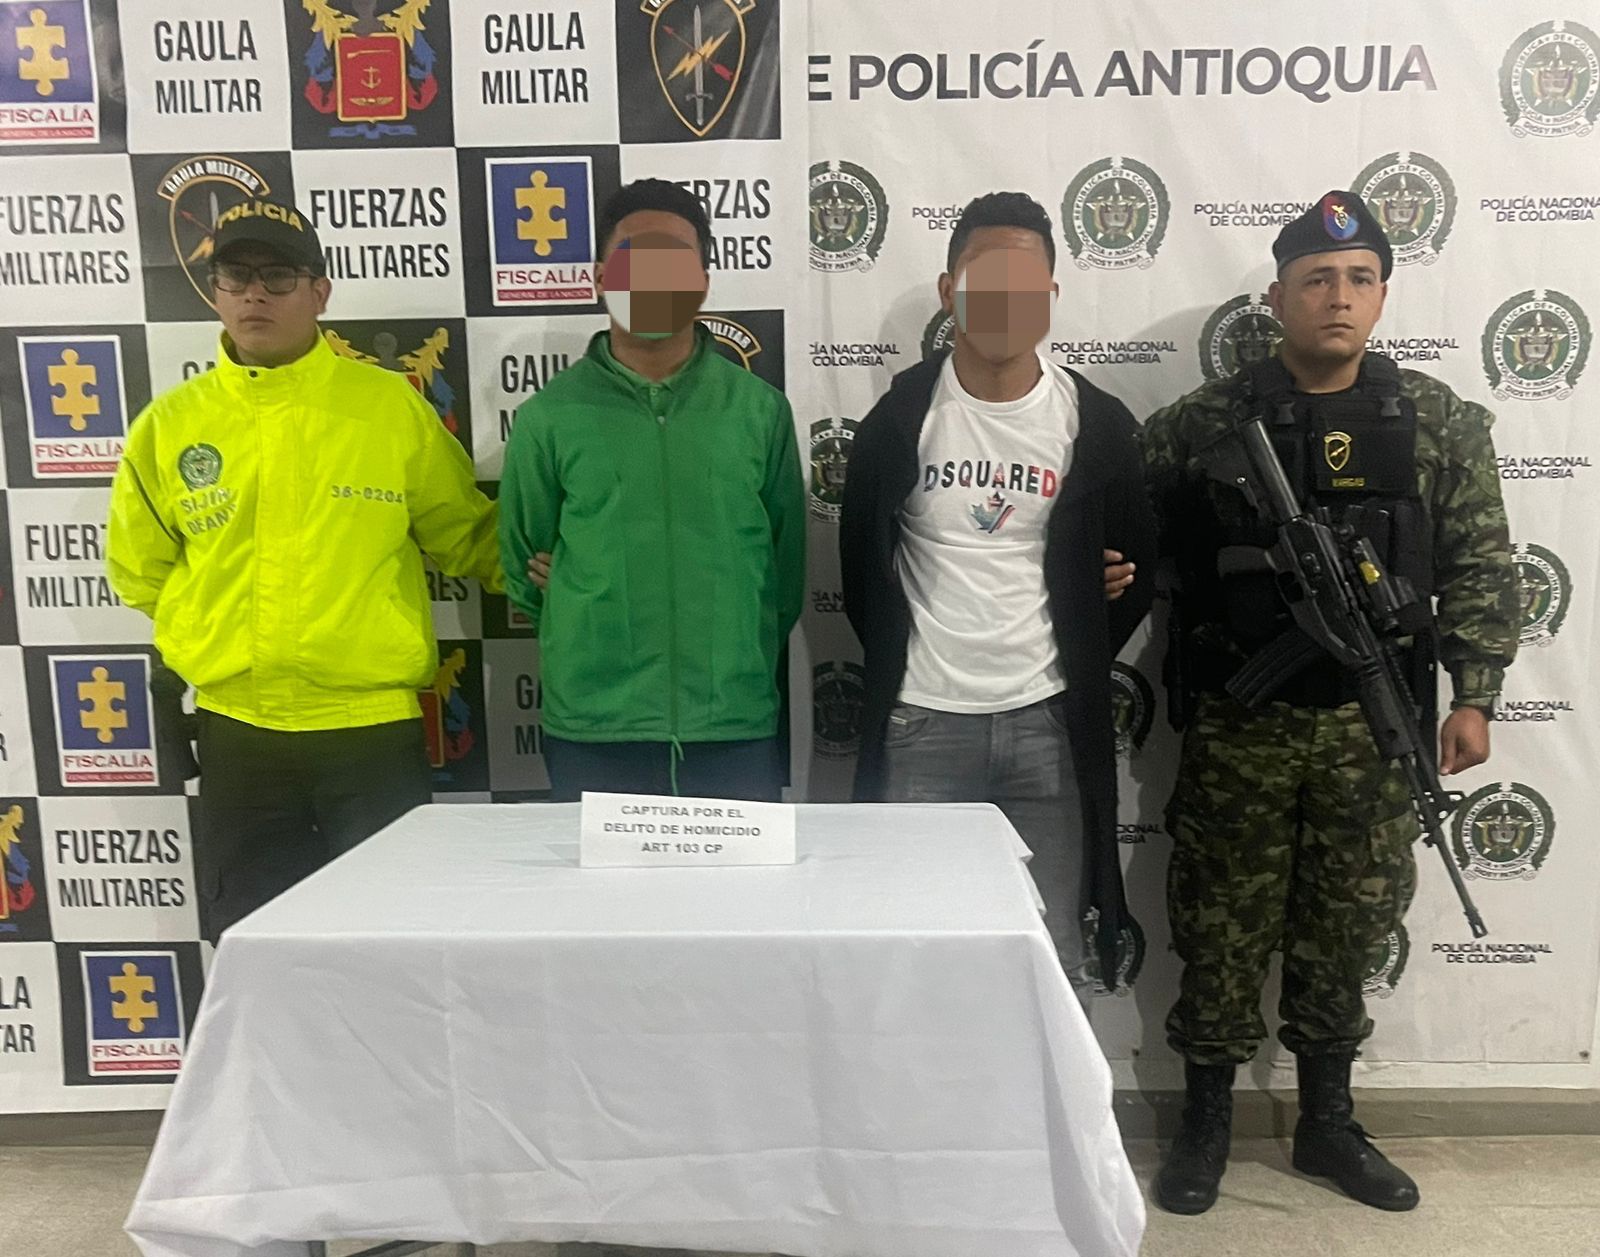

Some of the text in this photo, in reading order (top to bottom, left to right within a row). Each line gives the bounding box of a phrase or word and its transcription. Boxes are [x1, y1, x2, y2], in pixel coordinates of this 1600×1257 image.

[484, 12, 586, 54] GAULA
[154, 20, 258, 62] GAULA
[807, 39, 1438, 104] E POLICÍA ANTIOQUIA
[482, 68, 589, 105] MILITAR
[155, 78, 262, 114] MILITAR
[1362, 170, 1390, 199] UBLICA
[674, 179, 771, 220] RZAS
[1480, 195, 1600, 210] POLICÍA NACIONA
[310, 187, 447, 229] FUERZAS
[1194, 200, 1314, 214] POLICÍA NACIONA
[217, 200, 303, 232] POLICIA
[1210, 215, 1296, 226] DE COLOMB
[1496, 210, 1594, 222] DE COLOMBIA
[928, 220, 947, 230] DE
[496, 265, 592, 284] FISCALÍA
[830, 343, 900, 355] NACIONAL
[1051, 339, 1178, 353] POLICÍA NACIONAL
[1387, 338, 1460, 349] NACIONAL
[812, 355, 884, 366] COLOMBIA
[1067, 353, 1161, 364] DE COLOMBIA
[1383, 350, 1442, 361] LOMBIA
[1520, 456, 1592, 467] NACIONAL
[924, 460, 1056, 498] DSQUARED
[1502, 468, 1574, 479] COLOMBIA
[25, 524, 108, 561] FUER
[26, 576, 120, 608] MILITA
[1505, 701, 1574, 711] NACIONAL
[1495, 712, 1557, 722] OLOMBIA
[621, 805, 745, 819] CAPTURA POR EL
[603, 822, 761, 837] DELITO DE HOMICIDIO
[55, 829, 181, 865] FUERZAS
[641, 842, 723, 854] ART 103 CP
[59, 878, 186, 907] MILITARES
[1485, 944, 1553, 953] NACIONAL
[1446, 954, 1536, 963] DE COLOMBIA
